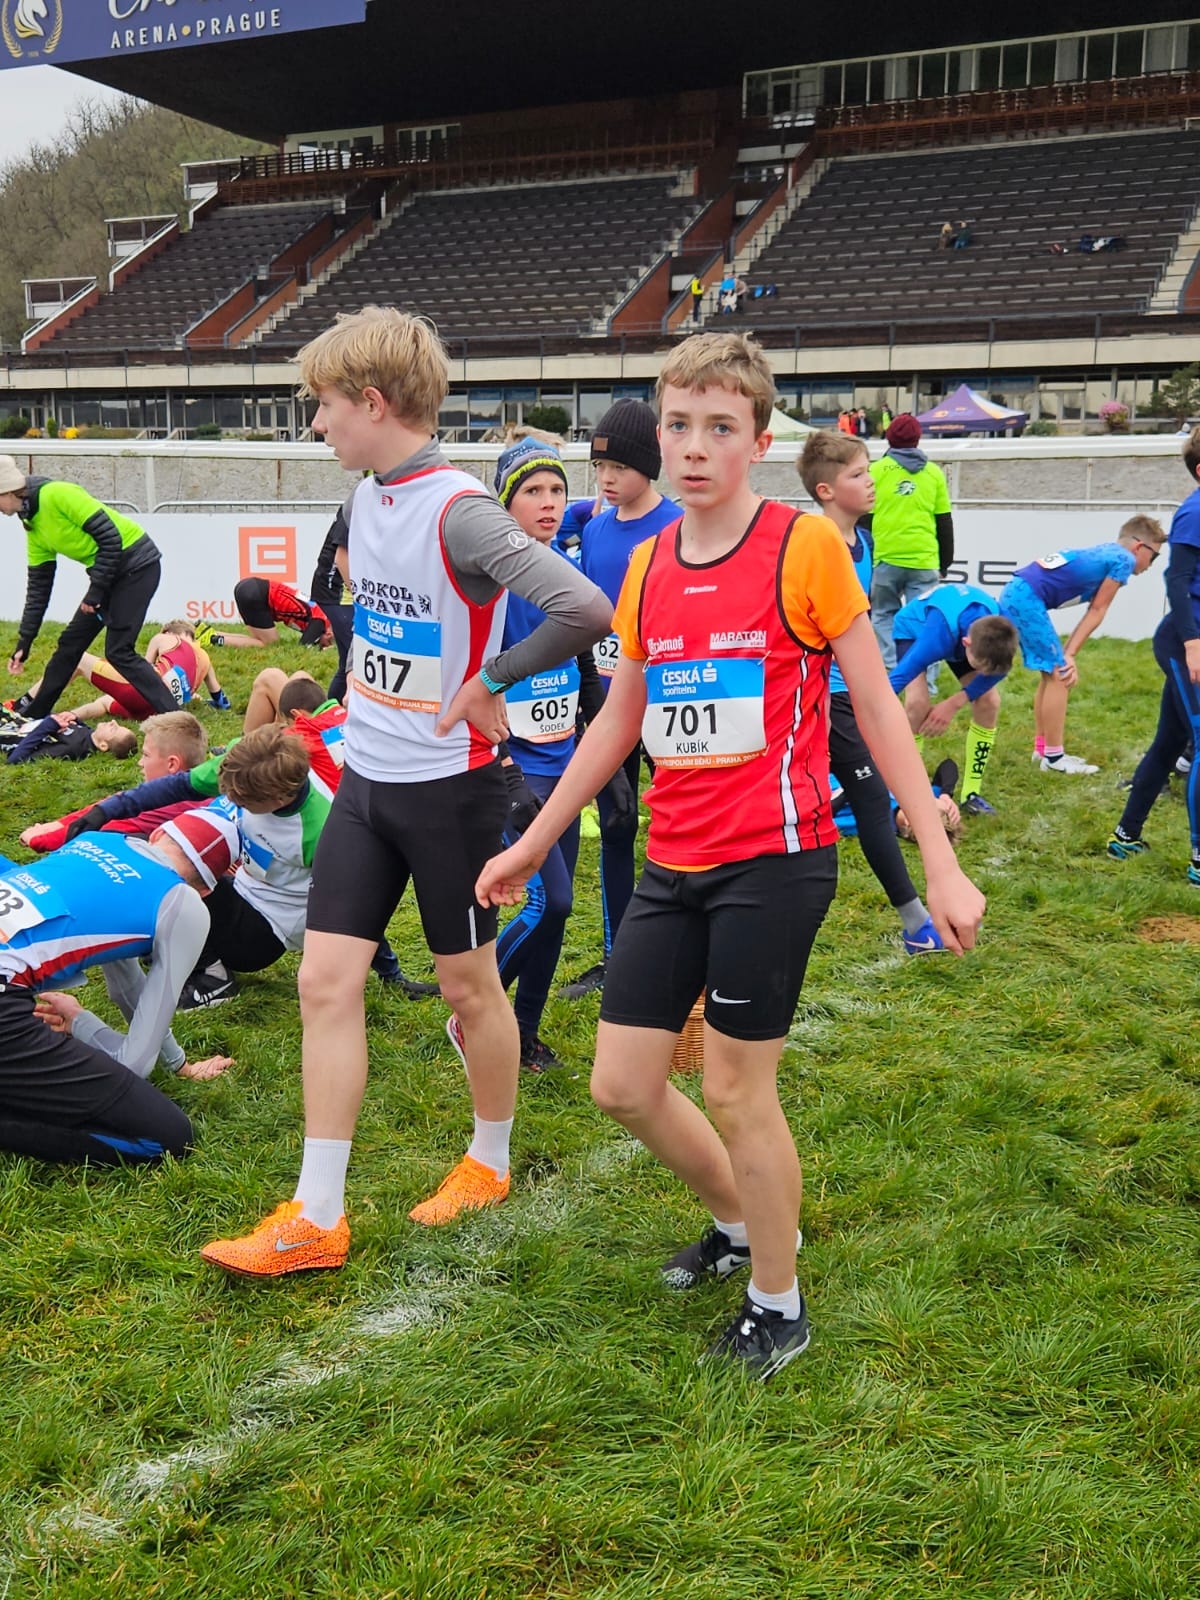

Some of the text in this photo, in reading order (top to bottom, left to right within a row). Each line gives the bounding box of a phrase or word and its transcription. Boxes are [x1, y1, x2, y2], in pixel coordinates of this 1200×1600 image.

[110, 23, 178, 49] ARENA
[196, 8, 281, 38] PRAGUE
[361, 578, 414, 601] SOKOL
[186, 600, 238, 619] SKU
[357, 594, 420, 618] OPAVA
[710, 630, 767, 642] MARATON
[599, 640, 619, 659] 62
[364, 649, 412, 694] 617
[531, 674, 560, 689] ČESKÁ
[662, 666, 701, 686] ČESKÁ
[662, 685, 697, 697] spořitelna
[531, 697, 569, 722] 605
[662, 704, 717, 737] 701
[676, 741, 709, 754] KUBÍK
[0, 888, 24, 917] 03
